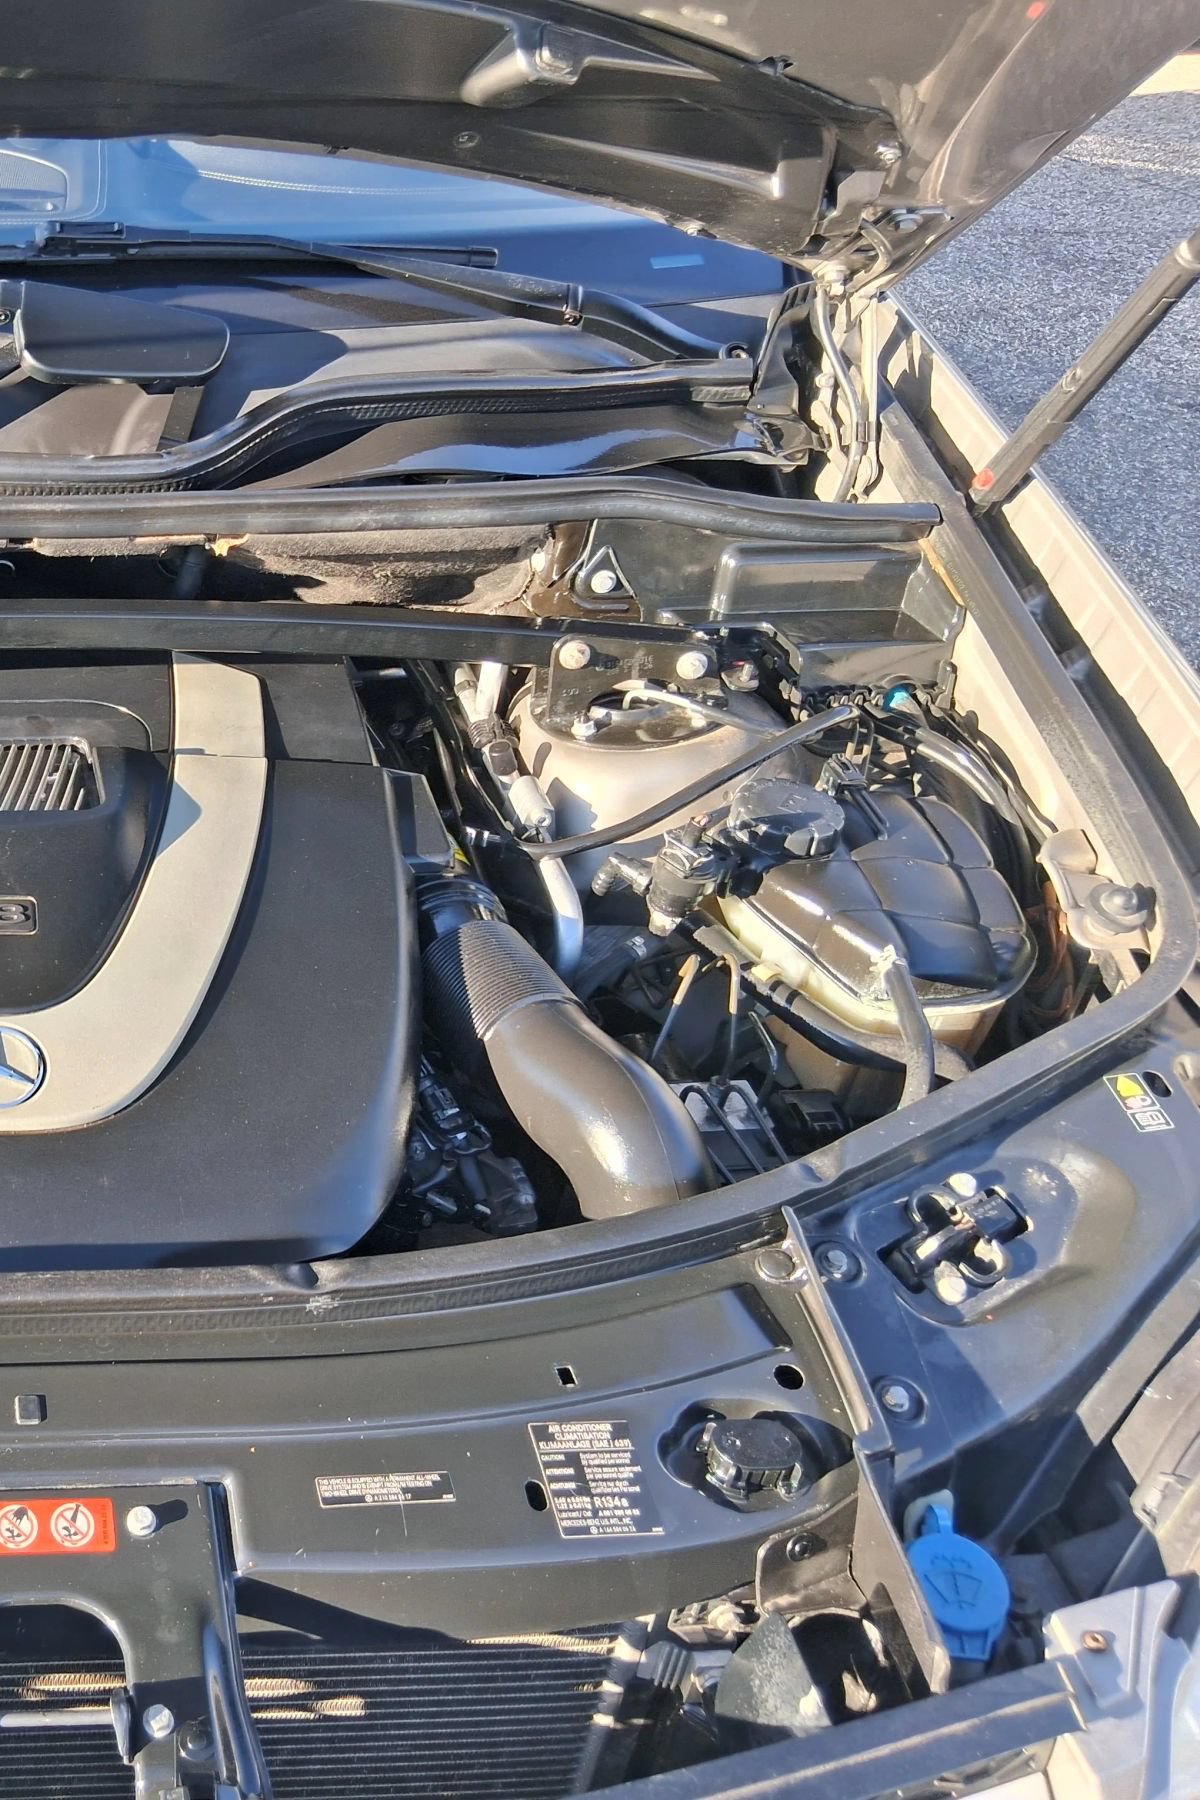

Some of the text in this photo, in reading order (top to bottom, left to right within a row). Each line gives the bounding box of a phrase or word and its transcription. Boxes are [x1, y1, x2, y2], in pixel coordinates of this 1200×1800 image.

[548, 1424, 613, 1433] AIR CONDITIONER
[538, 1440, 591, 1449] KLIMAANLAGE
[594, 1496, 629, 1508] R134a
